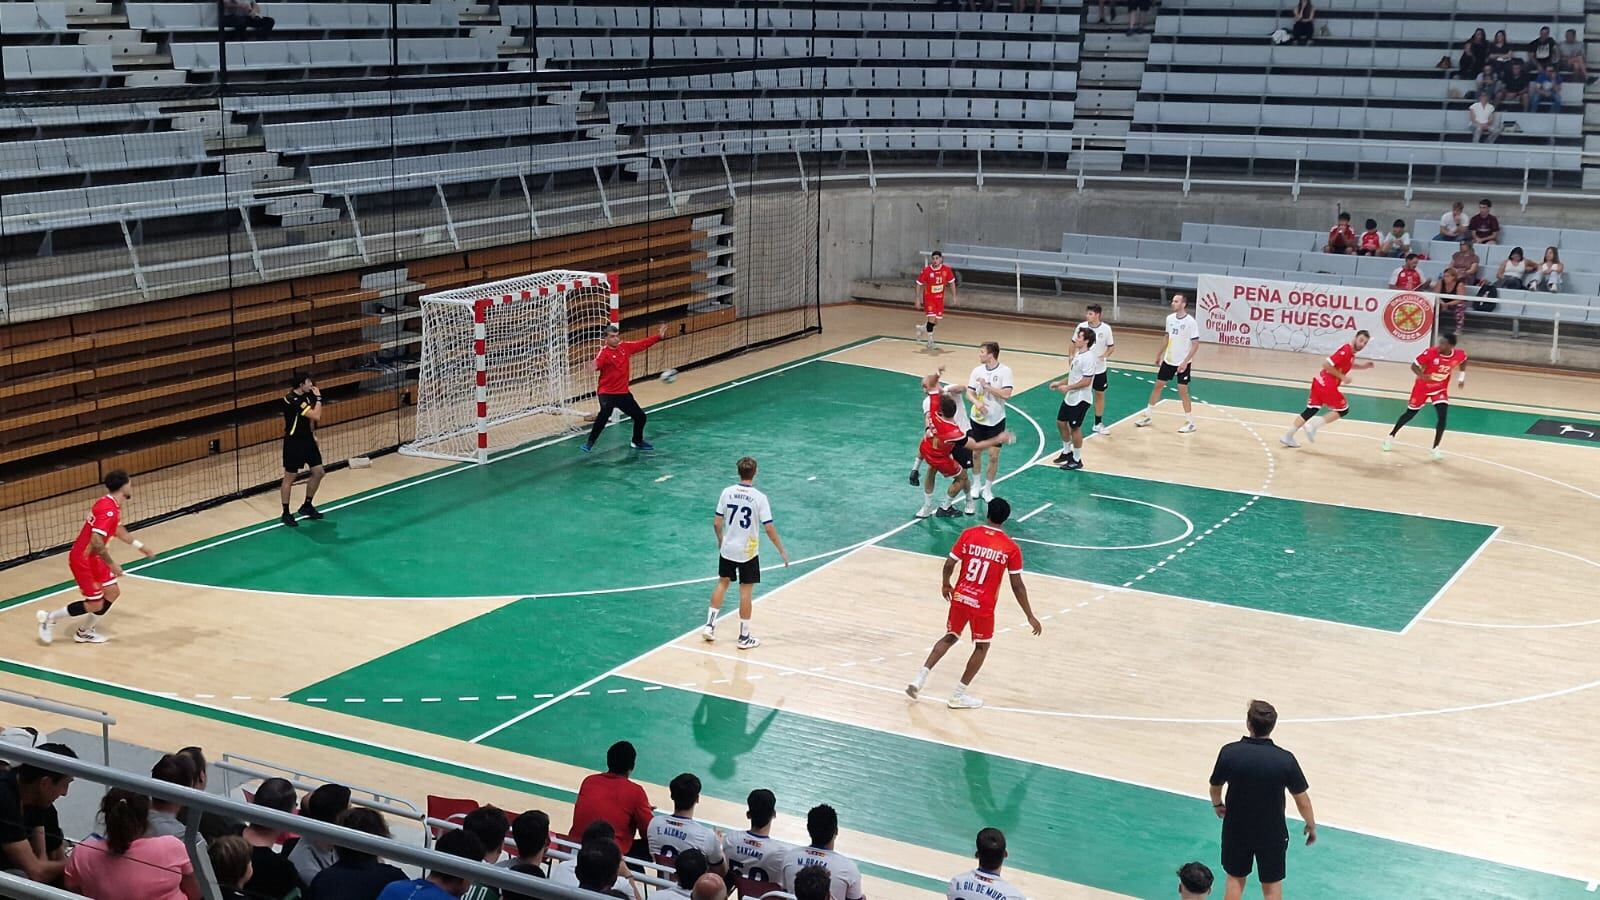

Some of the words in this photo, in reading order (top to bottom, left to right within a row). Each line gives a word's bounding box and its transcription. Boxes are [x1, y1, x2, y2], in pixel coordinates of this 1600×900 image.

[1233, 285, 1282, 303] PEÑA
[1288, 291, 1378, 312] ORGULLO
[1206, 319, 1237, 332] Orgullo
[1250, 307, 1275, 322] DE
[1281, 309, 1357, 330] HUESCA
[1219, 332, 1250, 345] Huesca
[727, 504, 752, 529] 73
[965, 558, 990, 585] 91
[664, 827, 687, 841] ALONSO
[964, 881, 974, 891] GIL
